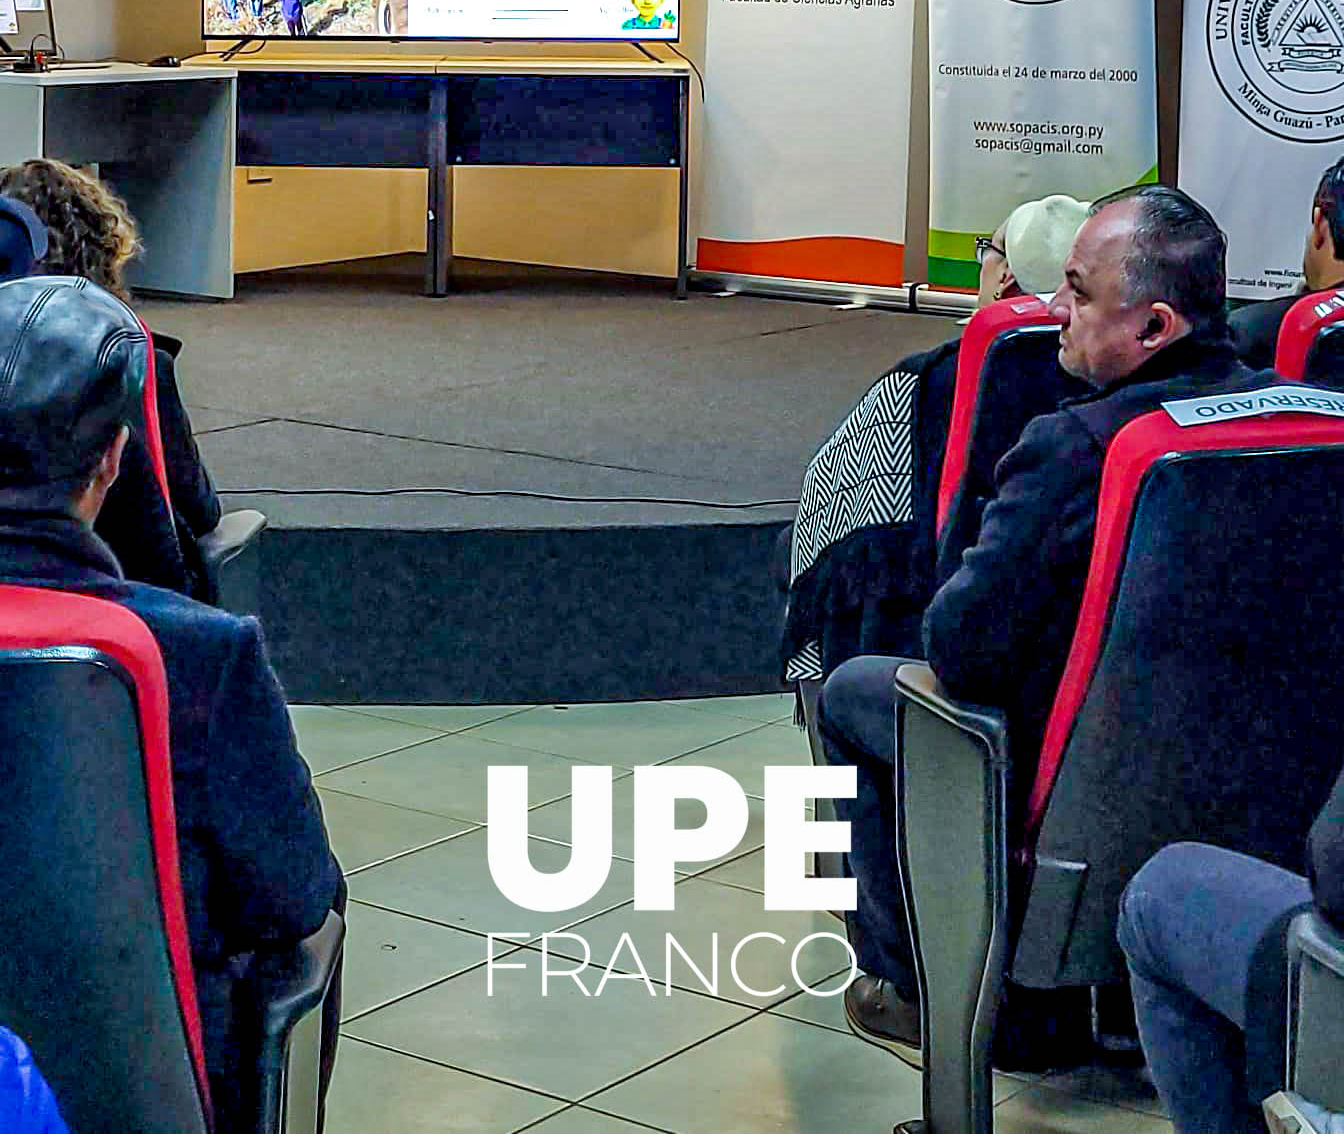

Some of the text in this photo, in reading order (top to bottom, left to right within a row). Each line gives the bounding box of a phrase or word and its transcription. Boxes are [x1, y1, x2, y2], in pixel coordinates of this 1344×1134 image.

[938, 64, 1138, 82] Constituida el 24 de marzo del 2000
[1237, 82, 1271, 117] Minga
[1273, 109, 1313, 129] Guazú
[973, 120, 1104, 139] www.sopacis.org.py
[975, 137, 1103, 156] sopacis@gmail.com
